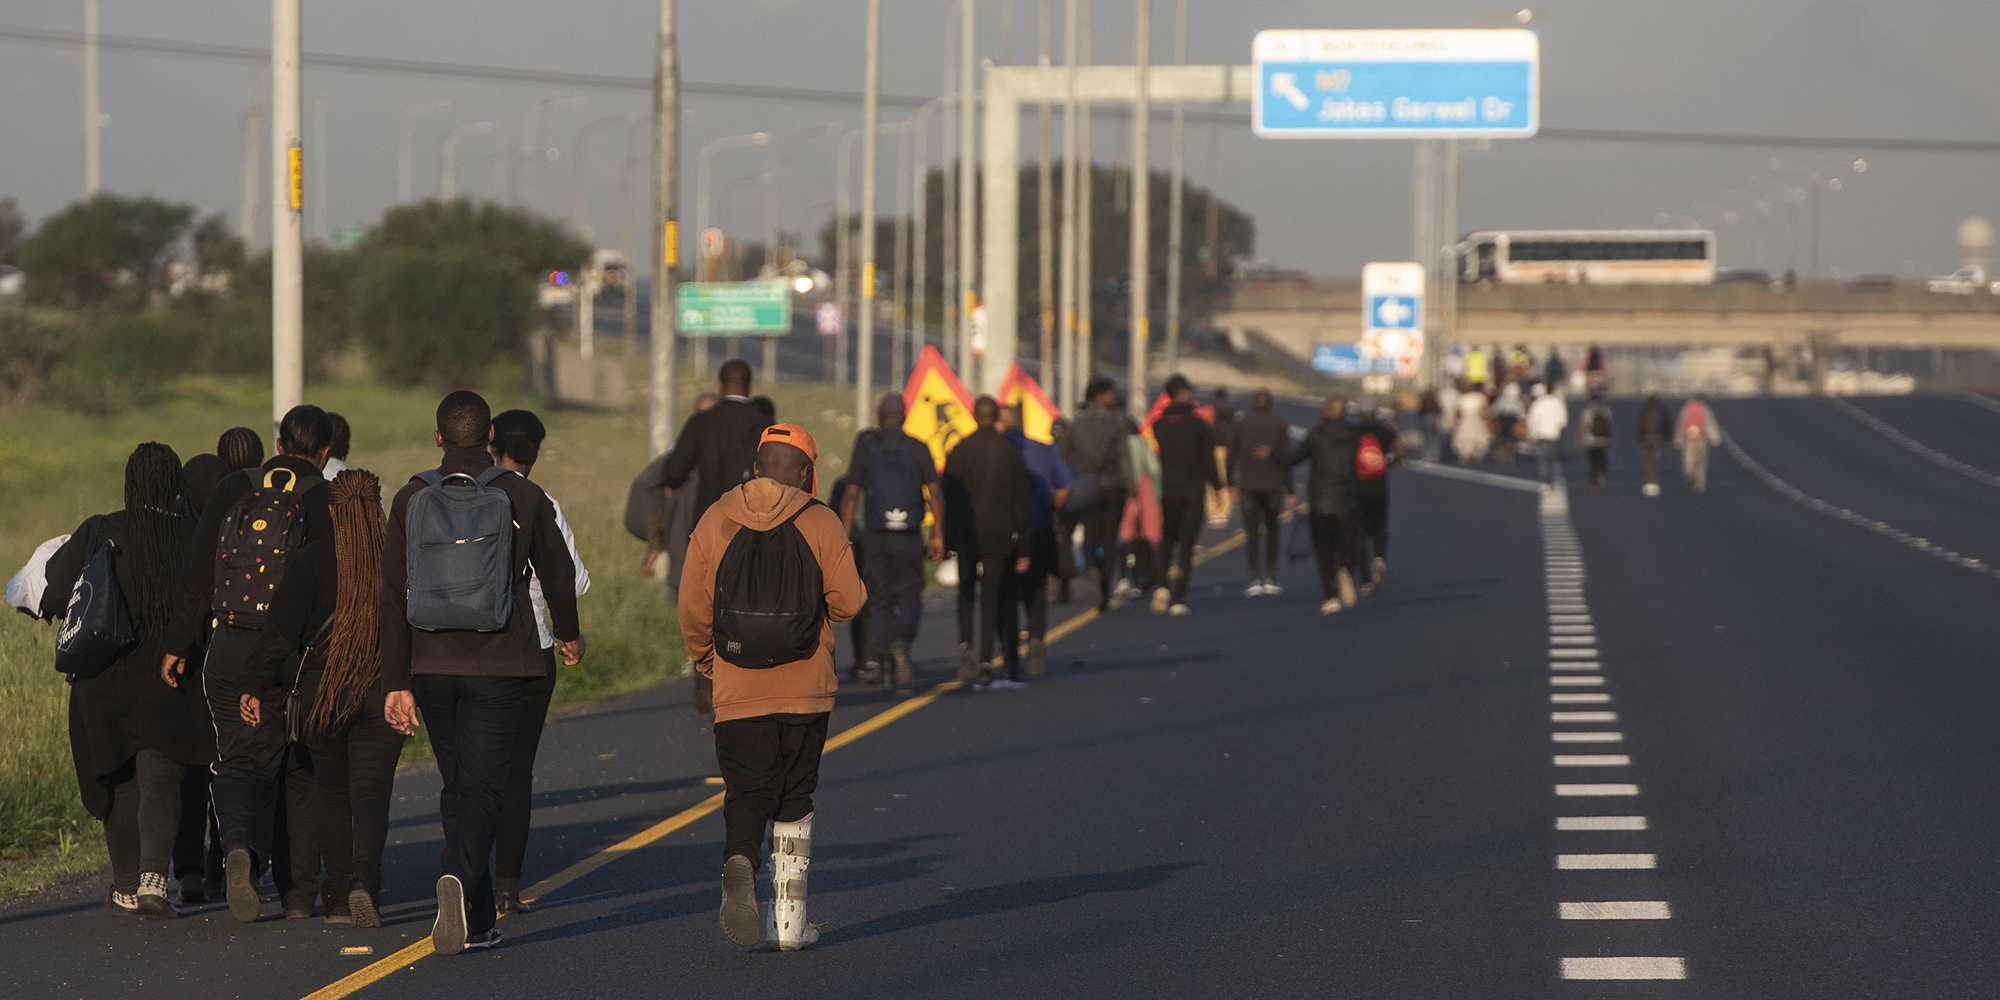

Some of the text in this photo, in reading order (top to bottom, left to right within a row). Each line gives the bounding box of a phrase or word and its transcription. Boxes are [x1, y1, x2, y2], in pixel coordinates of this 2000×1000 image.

[1317, 96, 1513, 121] Jakes Gerwel Dr
